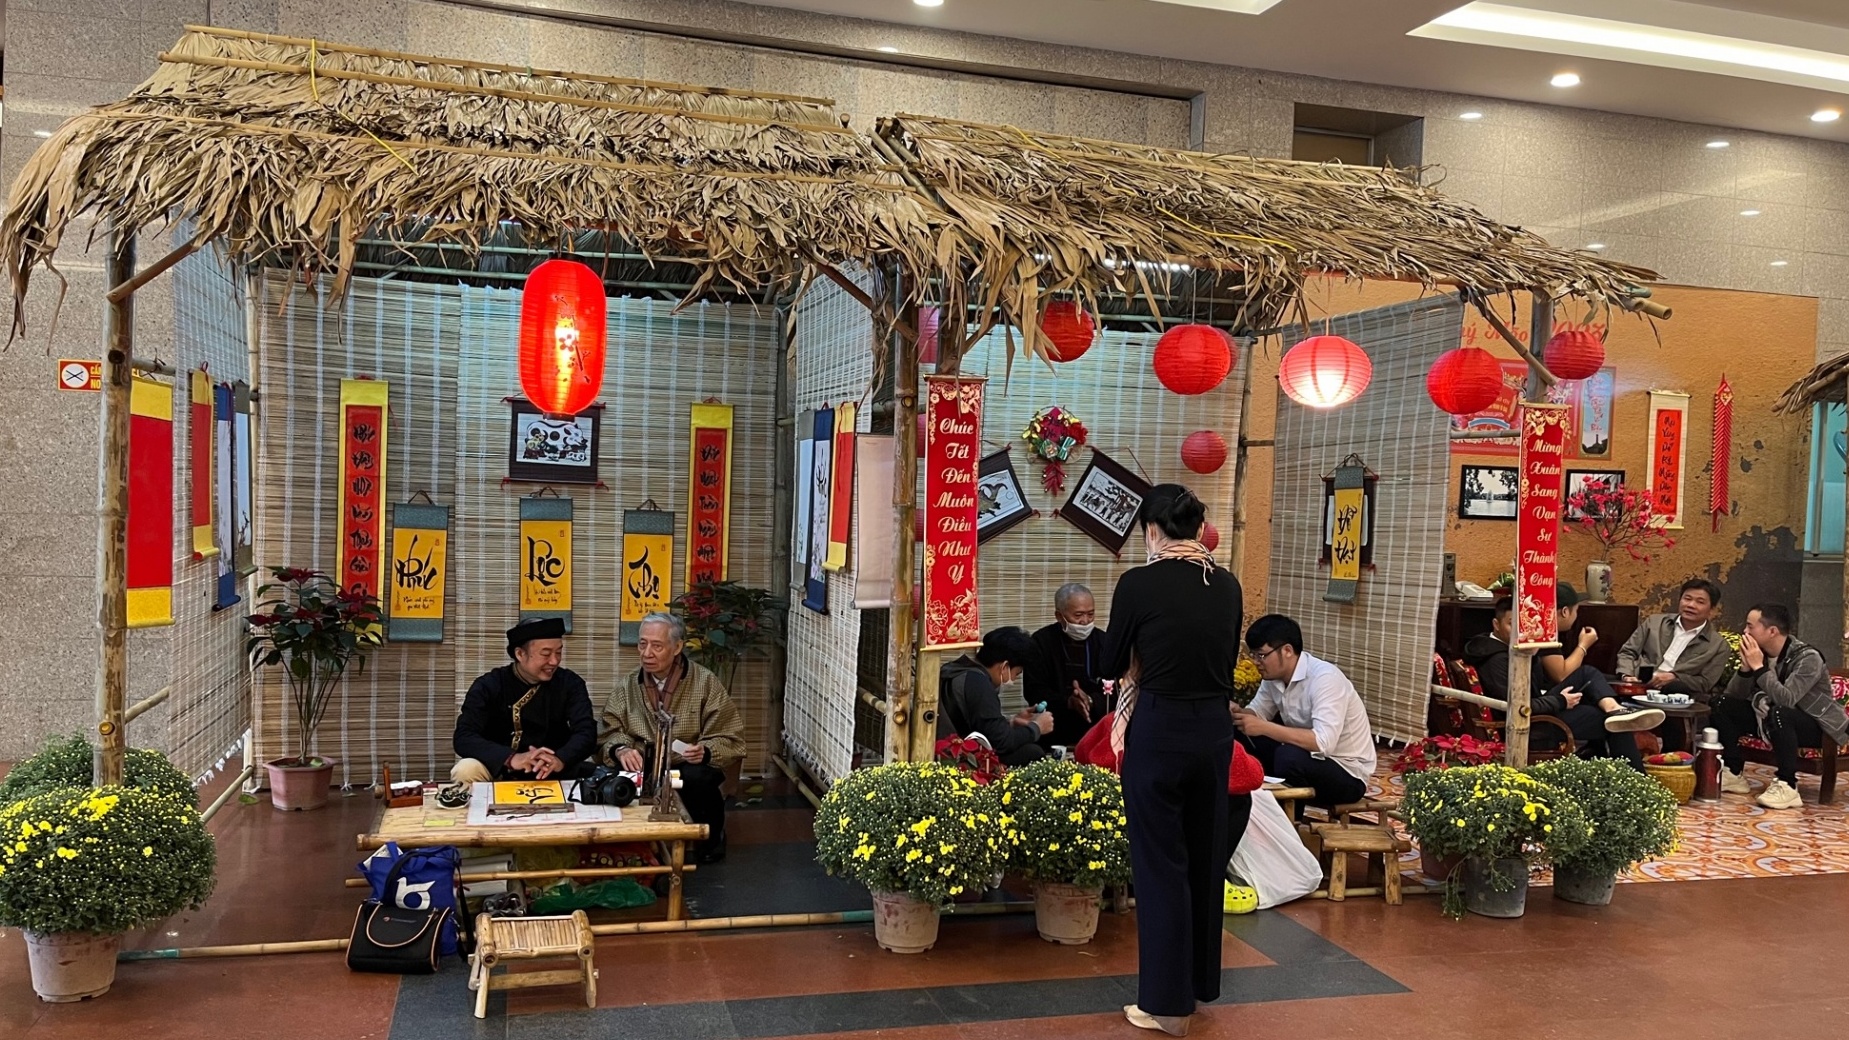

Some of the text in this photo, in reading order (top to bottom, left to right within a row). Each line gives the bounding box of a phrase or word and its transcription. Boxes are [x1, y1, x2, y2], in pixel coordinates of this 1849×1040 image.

[939, 417, 974, 435] Chúc
[945, 441, 970, 459] Tết
[1530, 439, 1562, 456] Mừng
[941, 467, 972, 484] Đến
[1530, 461, 1561, 475] Xuân
[933, 492, 974, 509] Muôn
[1530, 484, 1558, 500] Sang
[1532, 506, 1556, 522] Vạn
[938, 515, 972, 534] Điều
[1537, 528, 1552, 544] Sự
[938, 540, 971, 557] Như
[524, 535, 566, 586] Lộc
[1523, 550, 1555, 565] Thành
[947, 561, 964, 585] Ý
[1529, 572, 1554, 588] Công
